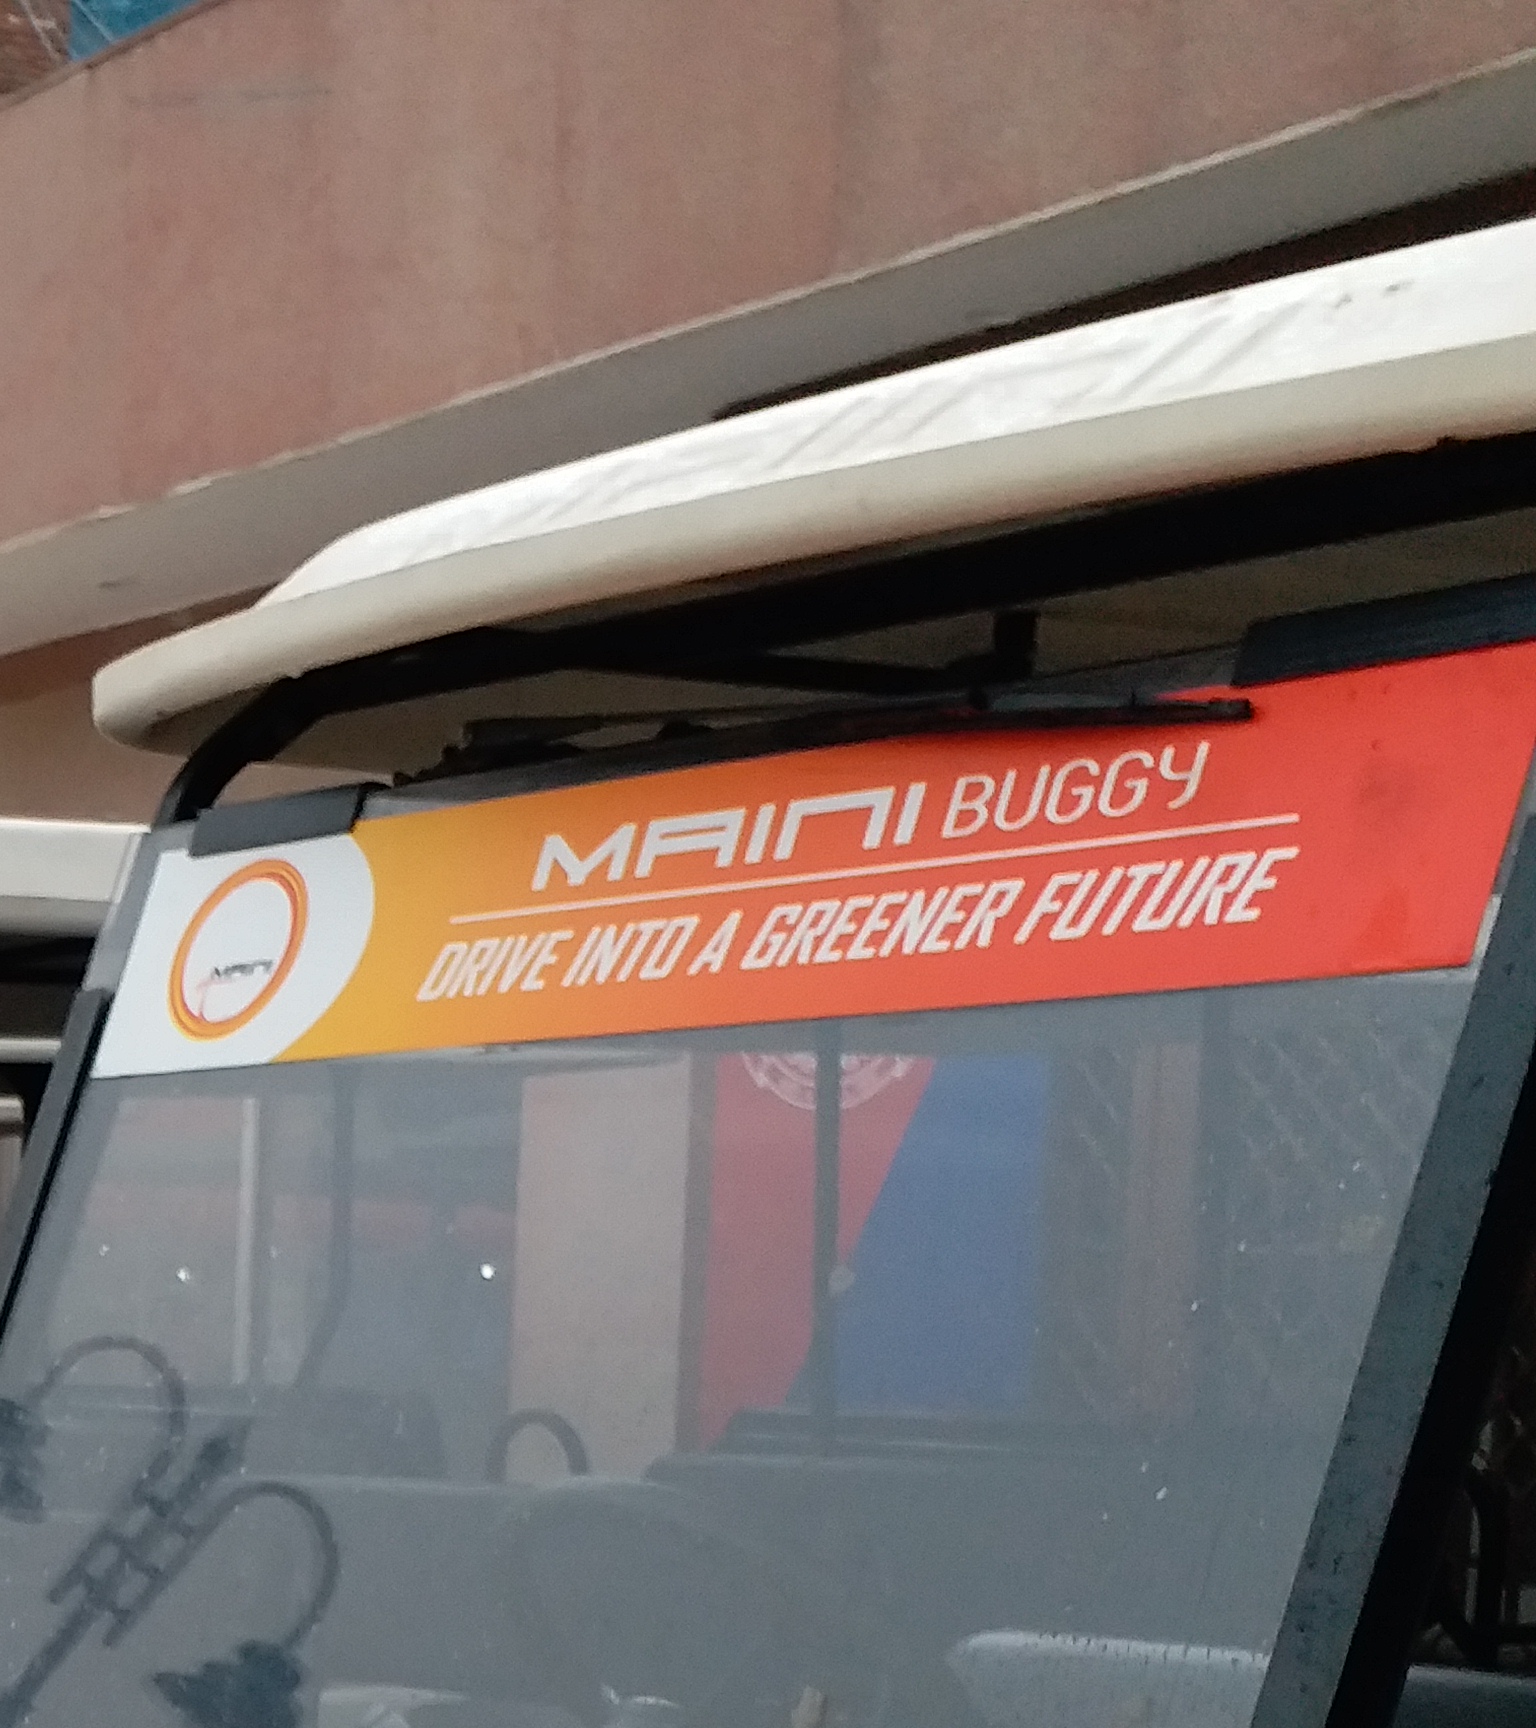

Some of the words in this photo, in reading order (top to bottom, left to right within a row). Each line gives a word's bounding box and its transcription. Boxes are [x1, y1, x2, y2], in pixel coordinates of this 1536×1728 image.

[530, 782, 927, 892] MAINI
[941, 740, 1211, 841] BUGGY
[416, 929, 574, 1003] DRIVE
[560, 914, 701, 988] INTO
[686, 911, 744, 976] A
[741, 877, 1026, 972] GREENER
[1013, 846, 1302, 946] FUTURE
